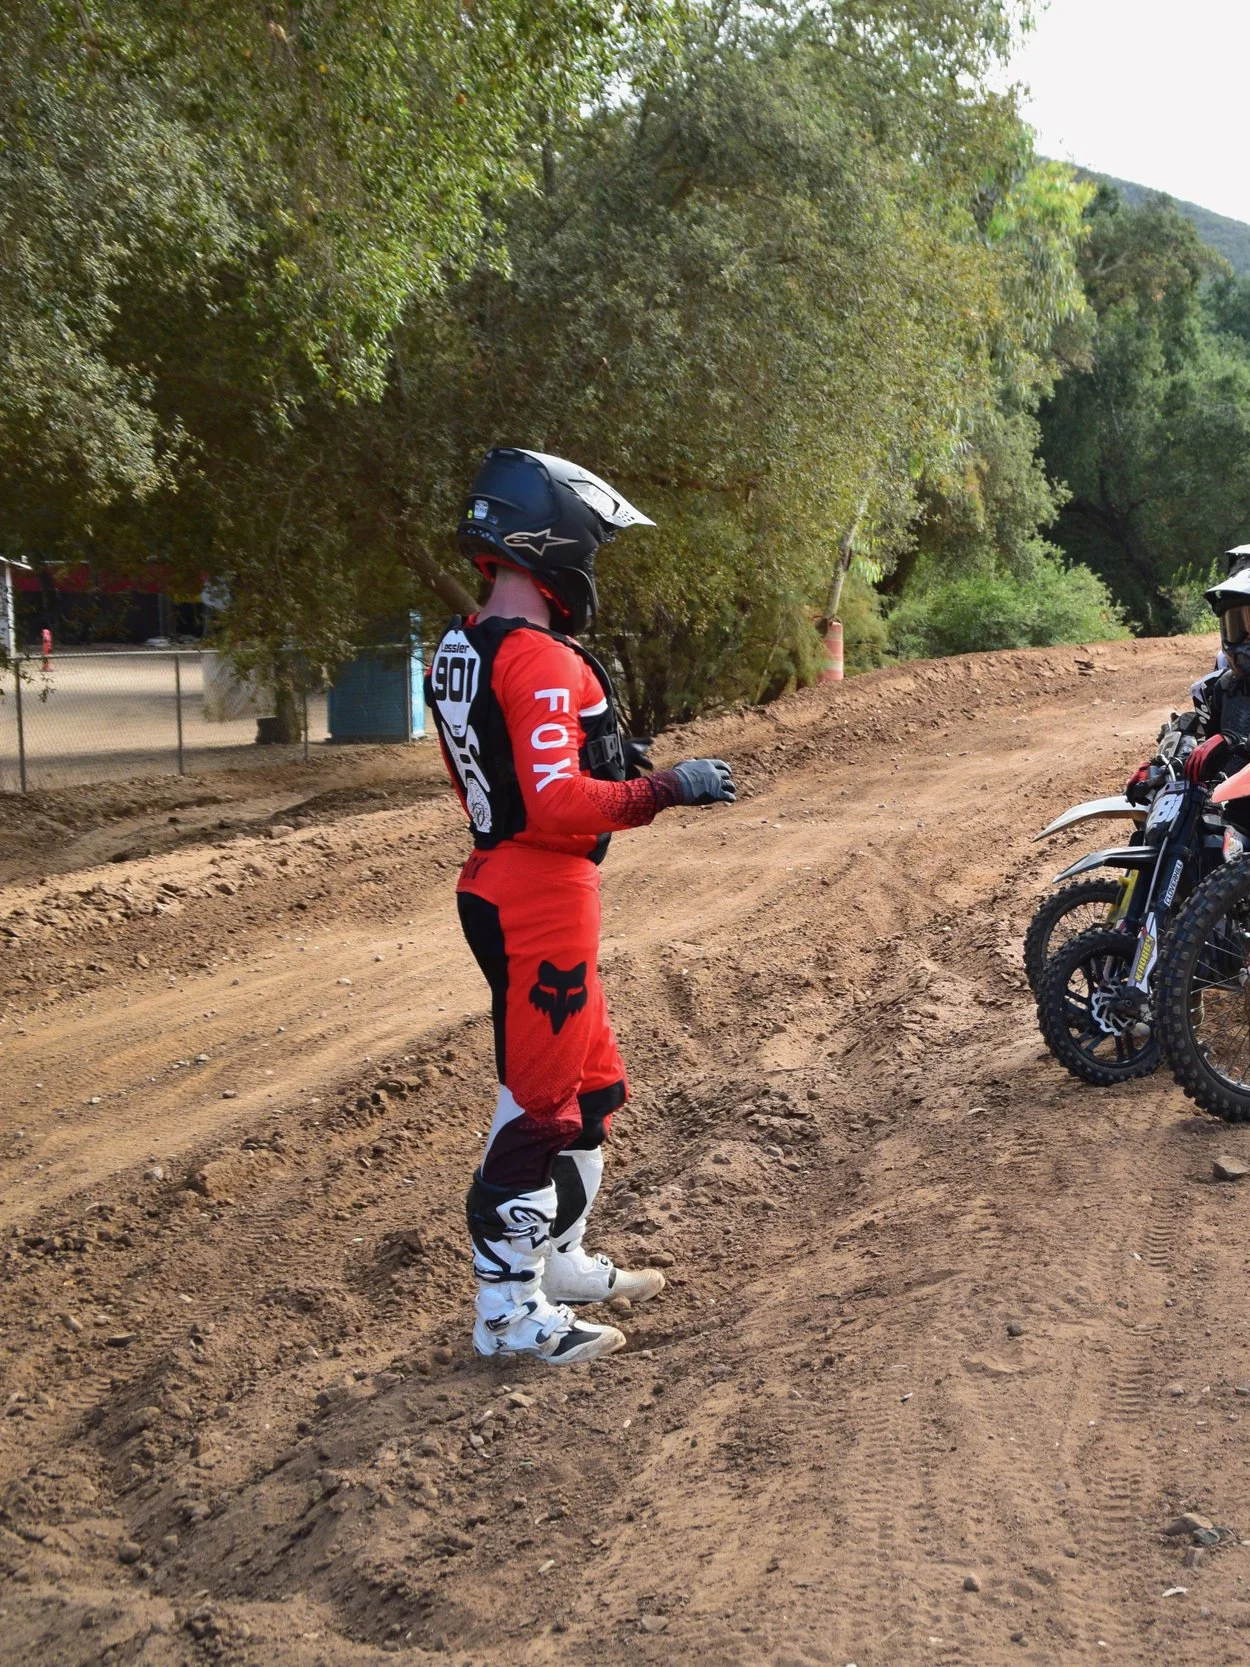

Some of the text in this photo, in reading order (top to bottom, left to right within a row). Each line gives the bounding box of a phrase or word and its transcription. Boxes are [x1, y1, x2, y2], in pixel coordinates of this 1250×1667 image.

[434, 656, 477, 703] 901
[531, 687, 574, 793] FOX
[1164, 860, 1183, 906] CLOVERHILL
